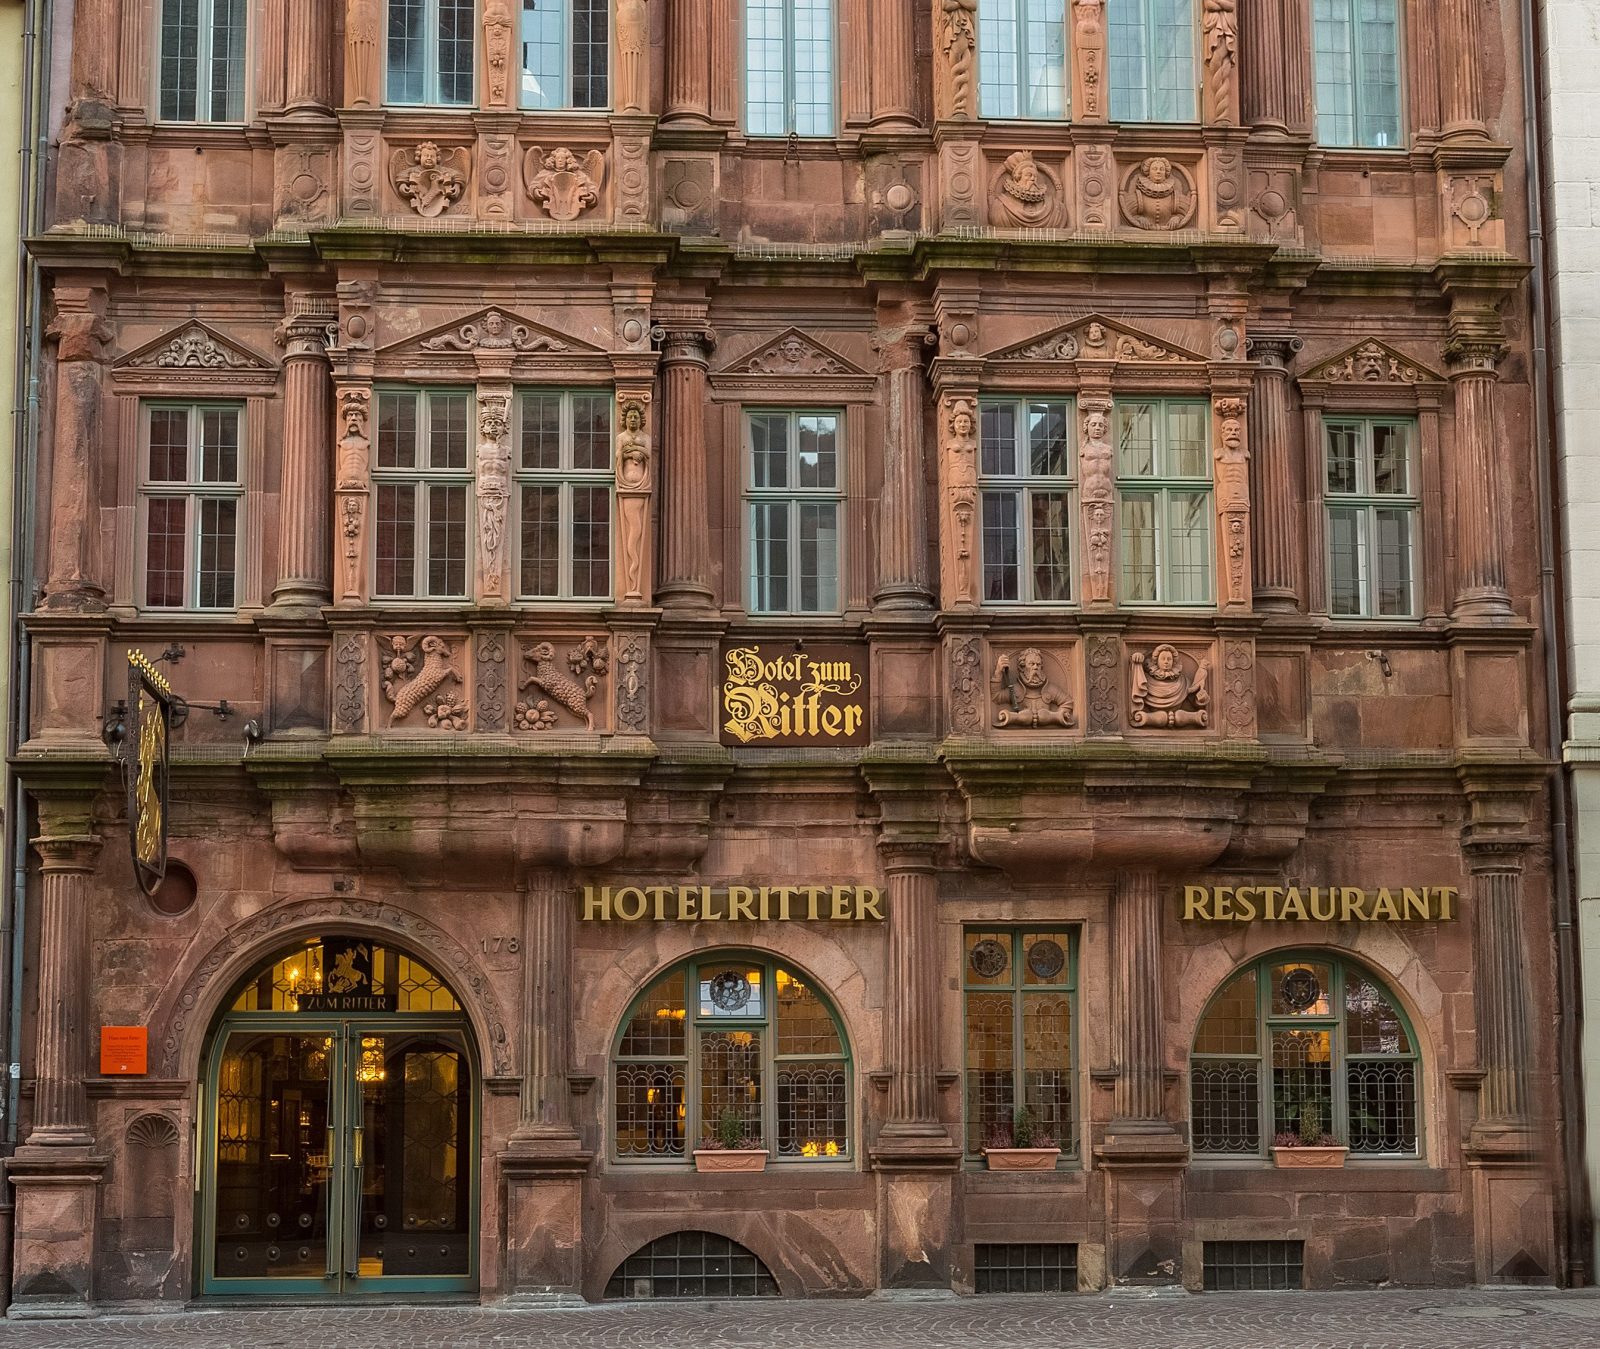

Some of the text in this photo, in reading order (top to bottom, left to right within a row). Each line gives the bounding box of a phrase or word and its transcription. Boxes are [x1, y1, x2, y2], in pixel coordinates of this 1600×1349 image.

[725, 645, 853, 687] Hotel zum
[724, 682, 863, 743] Ritter
[583, 886, 885, 921] HOTEL RITTER
[1183, 885, 1458, 921] RESTAURANT
[480, 935, 519, 953] 178
[307, 997, 386, 1009] ZUM RITTER
